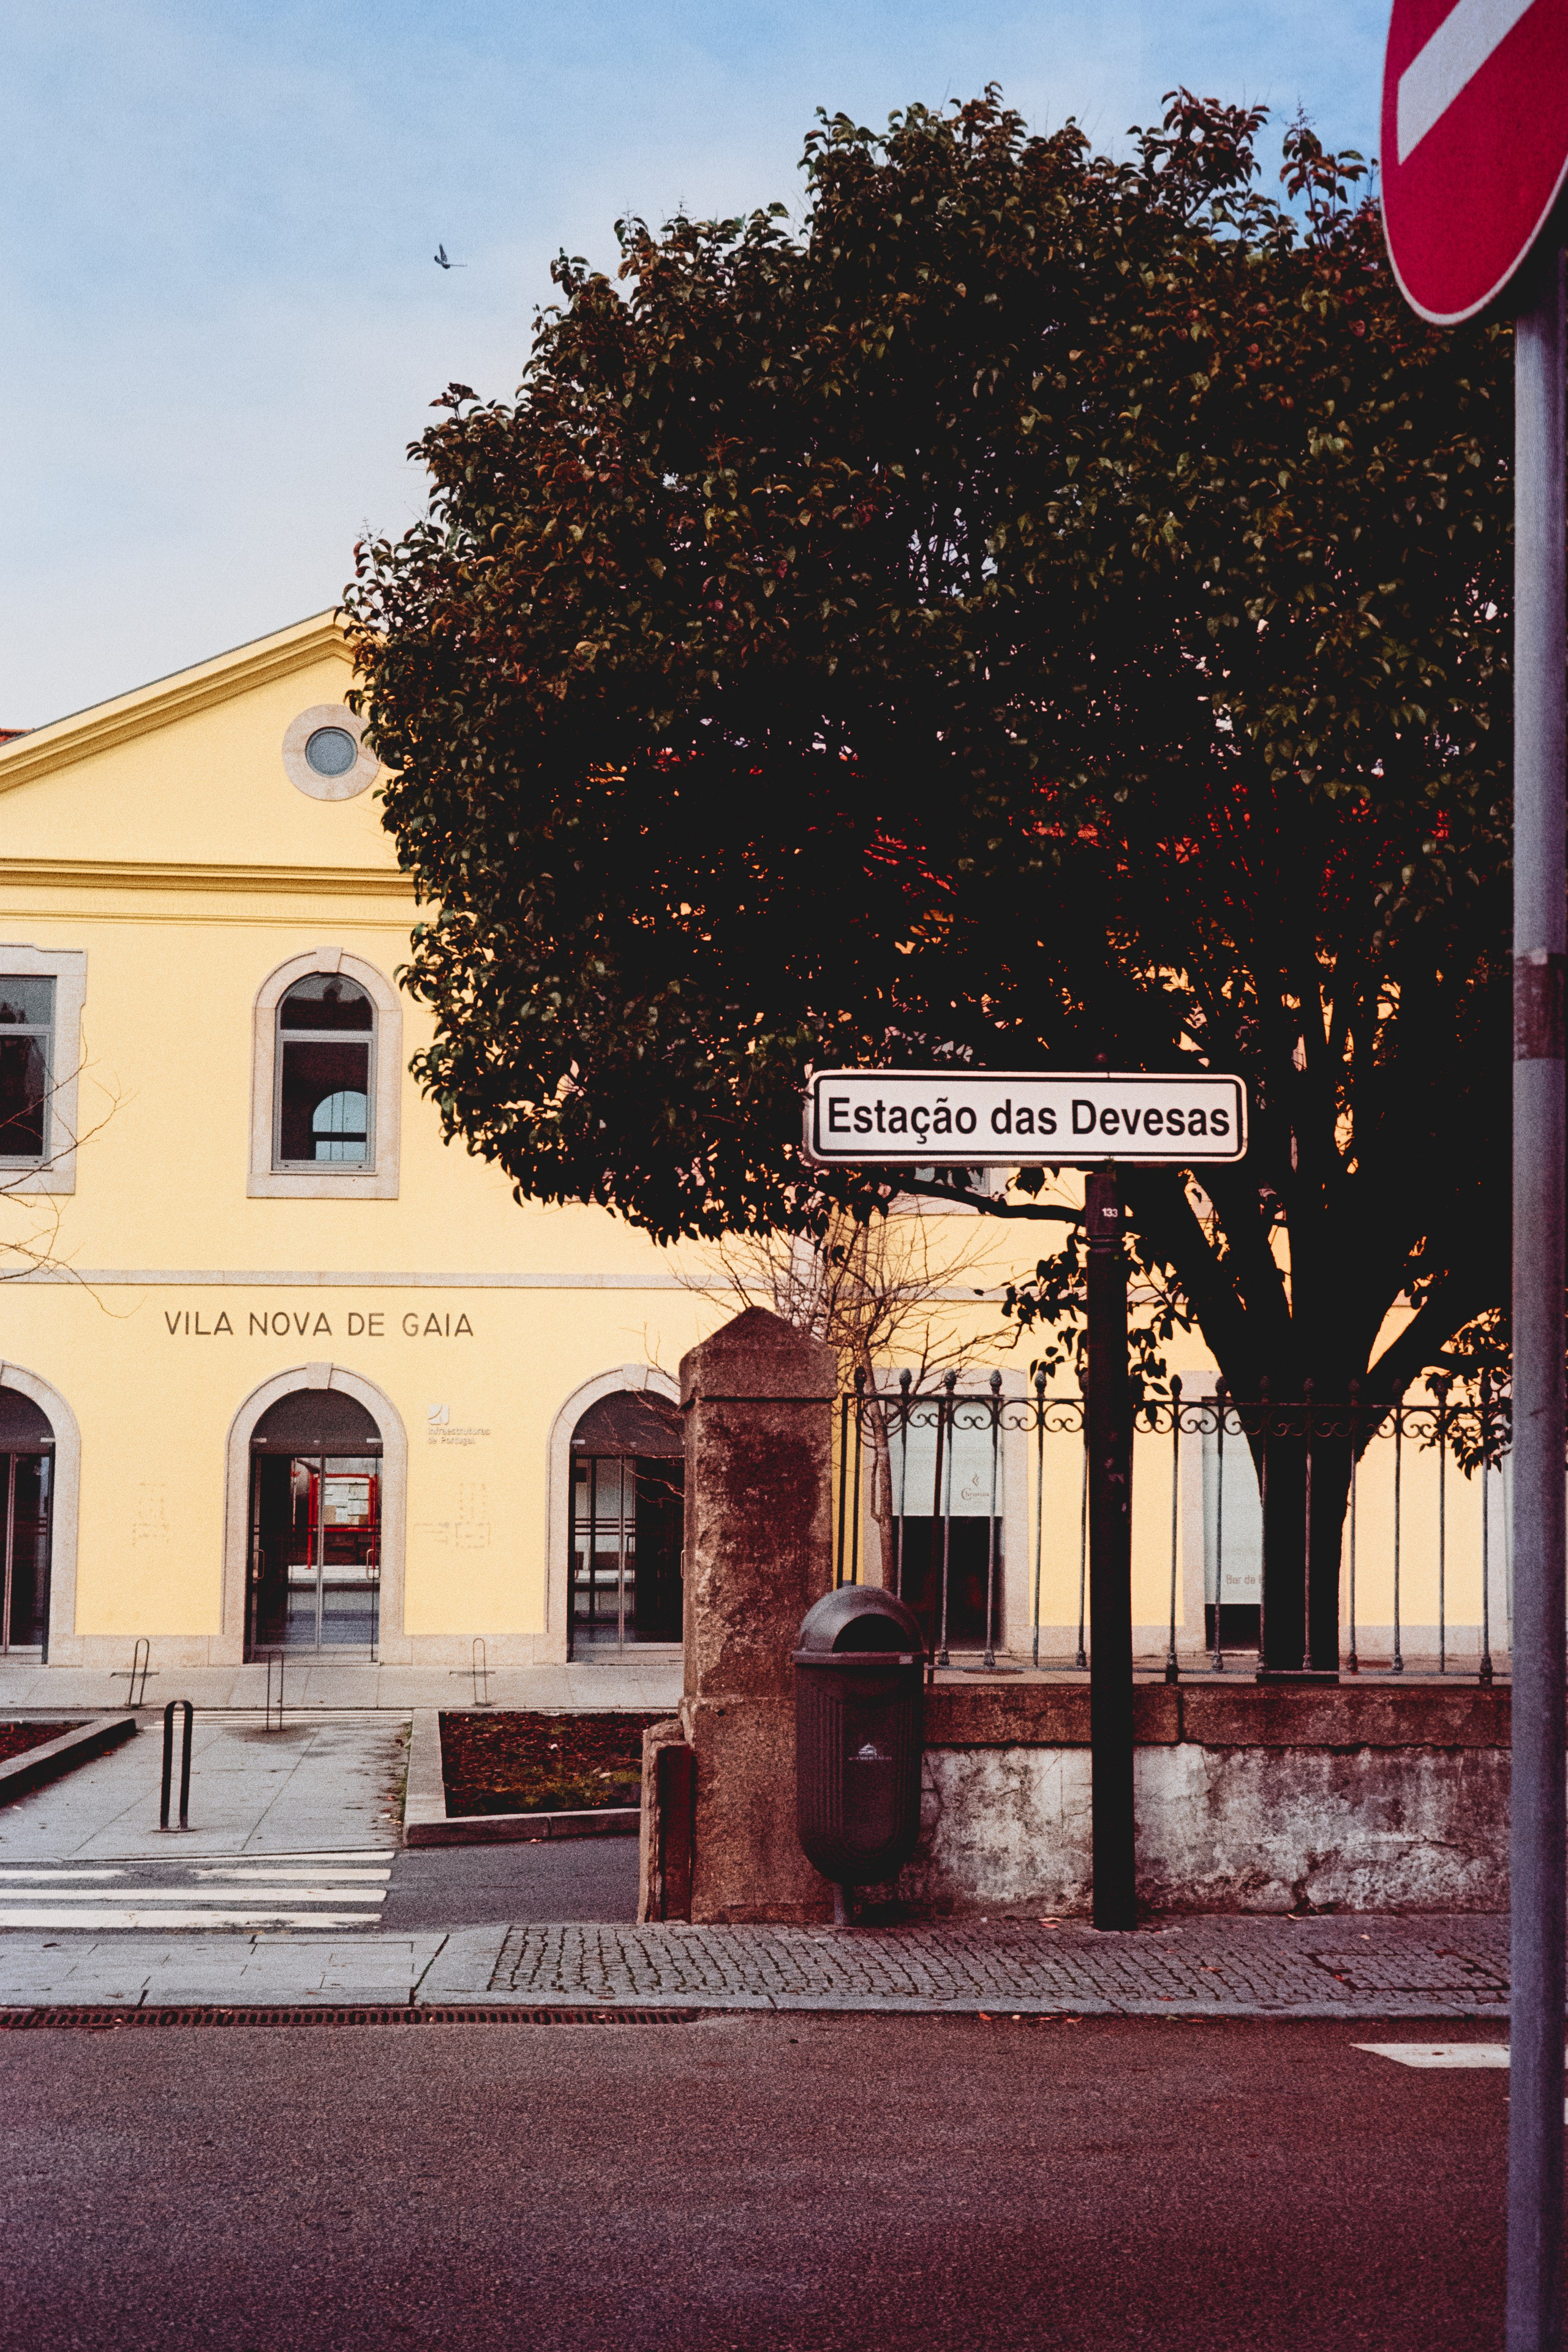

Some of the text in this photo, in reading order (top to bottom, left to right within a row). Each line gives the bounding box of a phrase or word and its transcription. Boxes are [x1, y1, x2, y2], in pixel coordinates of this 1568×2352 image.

[829, 1097, 1230, 1144] Estação das Devesas
[1102, 1207, 1118, 1218] 133
[164, 1311, 473, 1337] VILA NOVA DE GAIA
